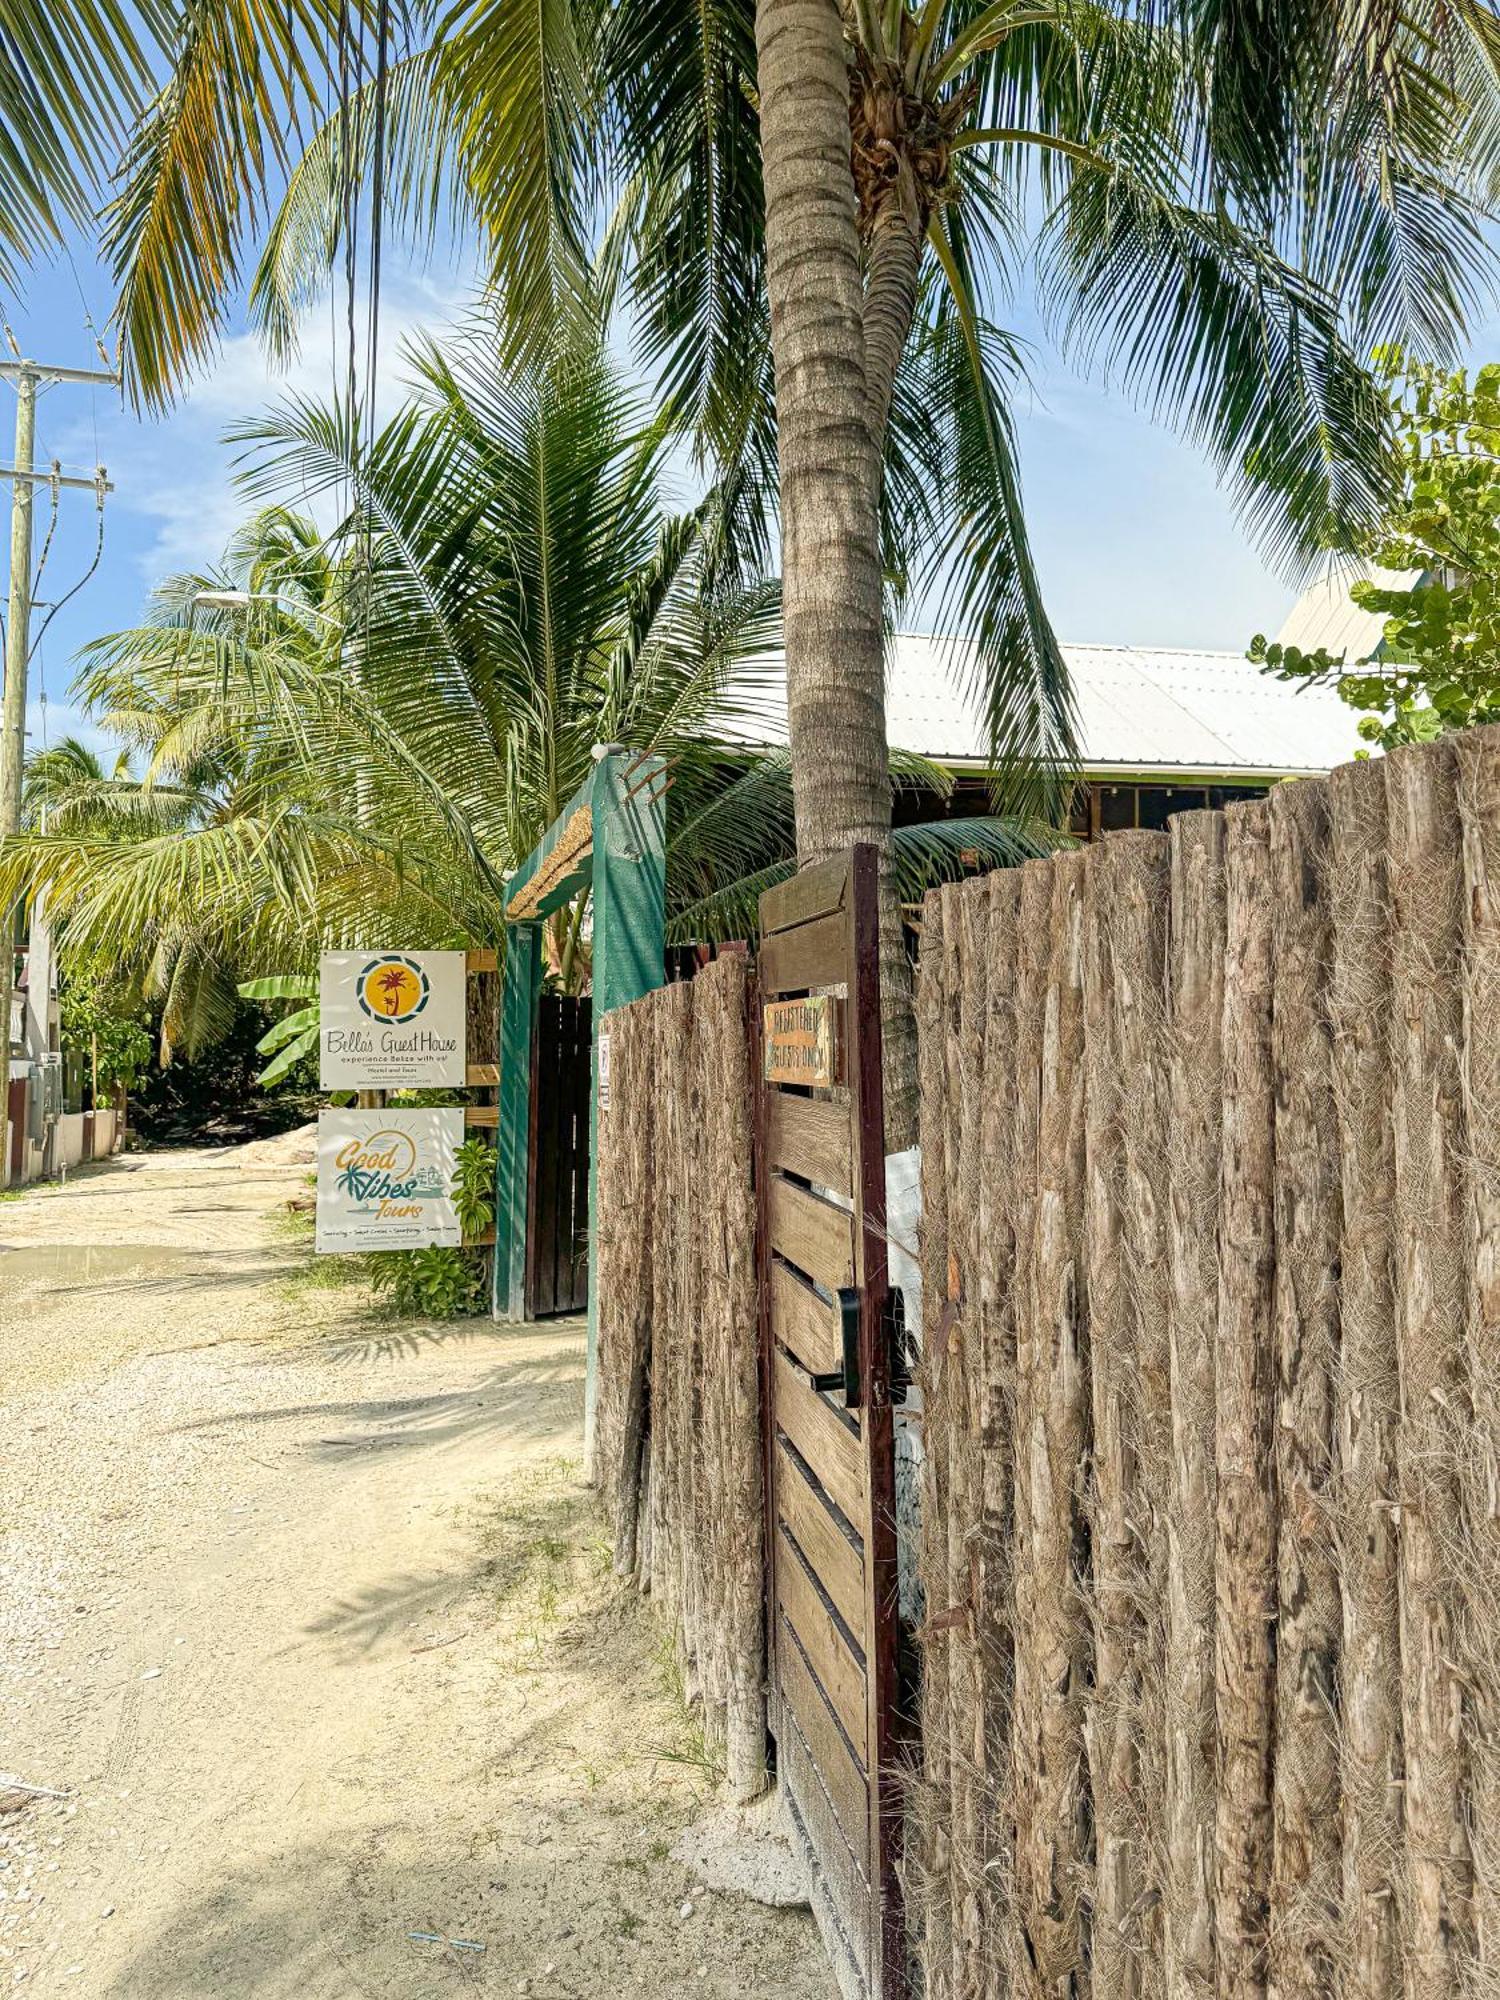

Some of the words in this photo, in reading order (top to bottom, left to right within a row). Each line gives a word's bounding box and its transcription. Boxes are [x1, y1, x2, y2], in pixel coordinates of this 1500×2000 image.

[327, 1031, 373, 1053] Bella's
[341, 1055, 388, 1064] experience
[335, 1139, 400, 1170] Good
[354, 1171, 418, 1201] Vibes
[375, 1199, 424, 1221] Tours
